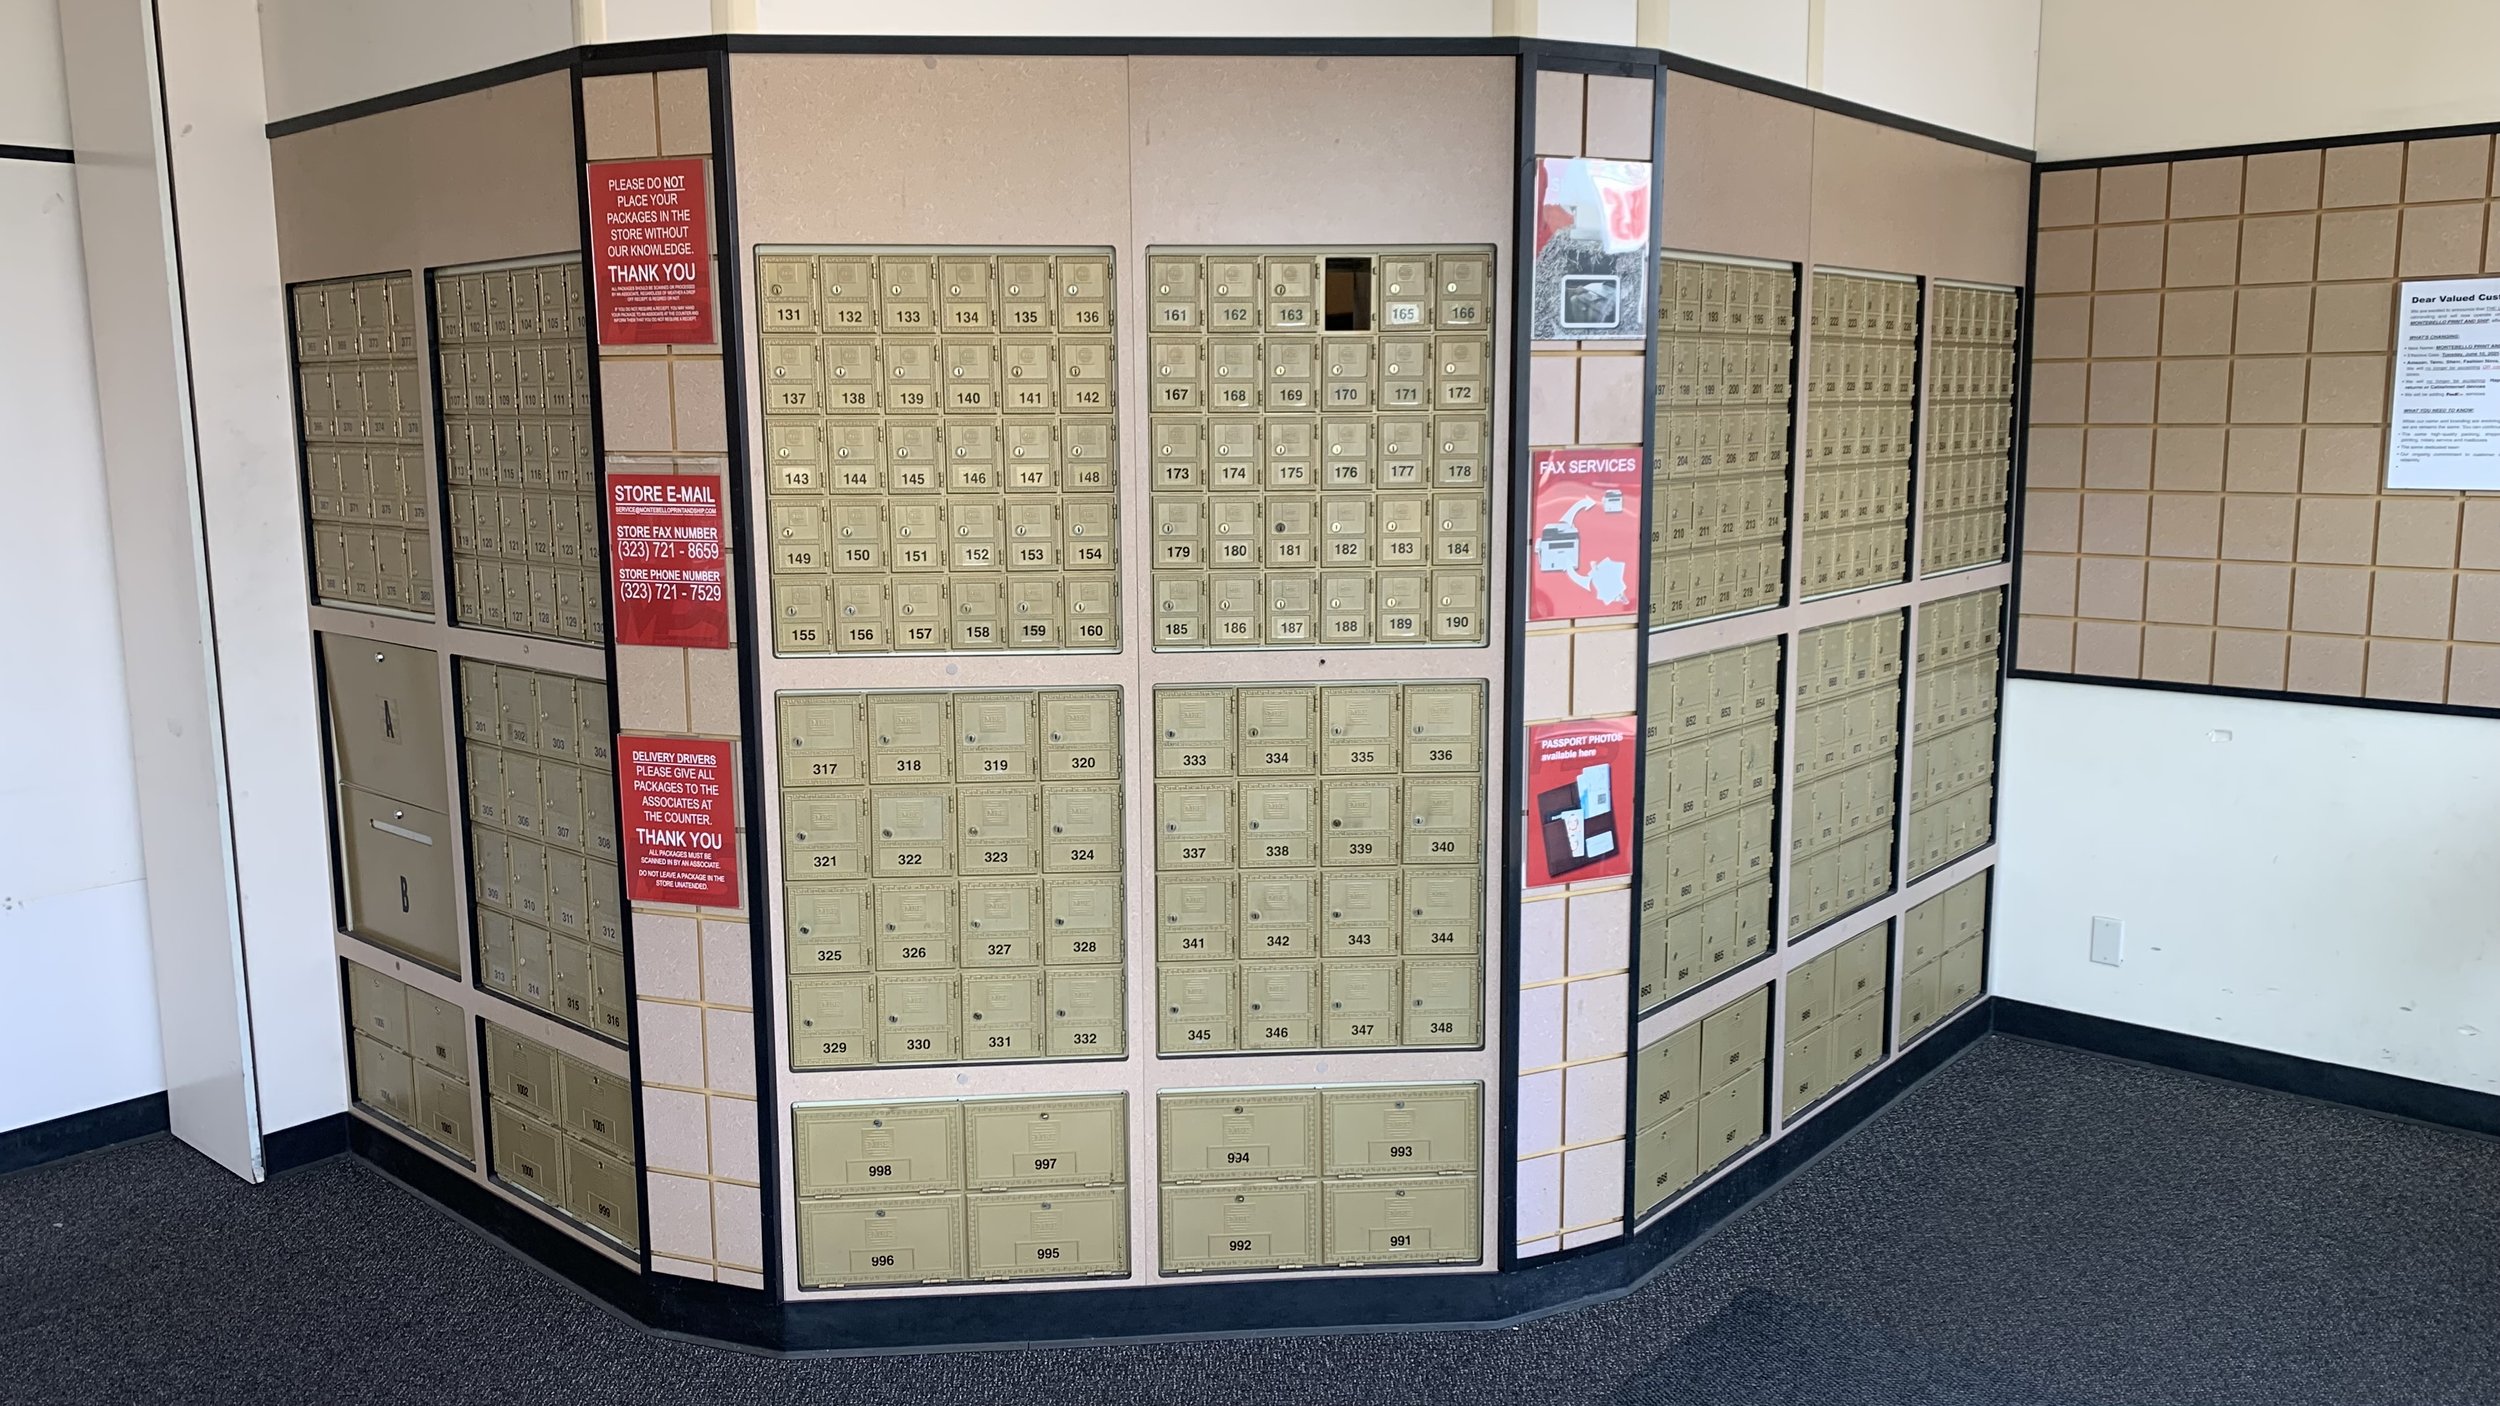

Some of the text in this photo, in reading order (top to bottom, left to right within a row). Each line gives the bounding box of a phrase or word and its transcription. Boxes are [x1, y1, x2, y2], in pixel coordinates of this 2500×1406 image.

[609, 176, 684, 191] PLEASE DO NOT
[618, 193, 677, 207] PLACE YOUR
[607, 210, 690, 224] PACKAGES IN THE
[611, 226, 688, 241] STORE WITHOUT
[608, 243, 694, 257] OUR KNOWLEDGE.
[608, 263, 695, 283] THANK YOU
[778, 309, 800, 320] 131
[838, 310, 862, 322] 132
[897, 311, 920, 323] 133
[956, 312, 978, 323] 134
[1015, 311, 1037, 323] 135
[1076, 311, 1099, 323] 136
[1164, 309, 1186, 321] 161
[1224, 309, 1247, 320] 162
[1280, 309, 1303, 321] 163
[1393, 308, 1414, 320] 165
[1452, 307, 1475, 319] 166
[521, 319, 532, 330] 104
[547, 318, 559, 329] 105
[1280, 467, 1303, 478] 175
[1335, 467, 1358, 478] 176
[1392, 465, 1414, 477] 177
[1449, 466, 1471, 477] 178
[1540, 459, 1636, 474] FAX SERVICES
[785, 473, 809, 485] 143
[844, 473, 867, 484] 144
[902, 473, 925, 485] 145
[963, 472, 986, 484] 146
[1021, 472, 1043, 483] 147
[1079, 471, 1100, 483] 148
[1167, 468, 1189, 479] 173
[1223, 468, 1246, 479] 174
[615, 486, 715, 502] STORE E-MAIL
[617, 526, 717, 539] STORE FAX NUMBER
[1699, 526, 1709, 537] 211
[535, 542, 546, 553] 122
[562, 544, 574, 556] 123
[618, 541, 649, 561] (323)
[653, 542, 675, 558] 721
[688, 543, 718, 559] 8659
[620, 569, 720, 582] STORE PHONE NUMBER
[621, 582, 652, 602] (323)
[656, 583, 677, 599] 721
[690, 584, 721, 601] 7529
[1696, 595, 1707, 607] 217
[565, 616, 577, 628] 129
[1281, 622, 1303, 633] 187
[1335, 621, 1357, 632] 188
[1390, 618, 1412, 629] 189
[1446, 616, 1468, 627] 190
[909, 628, 932, 639] 157
[967, 627, 990, 638] 158
[1023, 625, 1046, 636] 159
[1080, 625, 1103, 636] 160
[1166, 624, 1188, 635] 185
[1224, 622, 1246, 634] 186
[792, 630, 816, 641] 155
[850, 629, 873, 640] 156
[384, 700, 394, 738] A
[552, 738, 565, 750] 303
[1542, 732, 1623, 749] PASSPORT PHOTOS
[594, 746, 607, 759] 304
[633, 751, 716, 764] DELIVERY DRIVERS
[1266, 752, 1289, 764] 334
[1351, 752, 1374, 763] 335
[1430, 750, 1452, 761] 336
[1542, 749, 1596, 761] available here
[897, 760, 921, 771] 318
[984, 760, 1008, 771] 319
[1072, 757, 1095, 768] 320
[1183, 755, 1206, 766] 333
[637, 766, 714, 780] PLEASE GIVE ALL
[813, 764, 837, 775] 317
[634, 780, 719, 795] PACKAGES TO THE
[642, 796, 712, 810] ASSOCIATES AT
[644, 811, 712, 825] THE COUNTER.
[636, 828, 722, 849] THANK YOU
[659, 850, 687, 858] PACKAGES
[682, 873, 706, 881] PACKAGE
[400, 875, 409, 913] B
[1183, 938, 1204, 949] 341
[1267, 936, 1289, 946] 342
[1348, 934, 1371, 945] 343
[1431, 932, 1454, 943] 344
[902, 947, 926, 958] 326
[988, 944, 1011, 955] 327
[1073, 941, 1096, 952] 328
[818, 950, 842, 961] 325
[567, 997, 579, 1011] 315
[607, 1014, 620, 1027] 316
[517, 1083, 529, 1097] 1002
[592, 1119, 605, 1133] 1001
[1391, 1146, 1412, 1157] 993
[1035, 1158, 1057, 1170] 997
[521, 1164, 533, 1178] 1000
[869, 1165, 892, 1177] 998
[599, 1203, 610, 1218] 999
